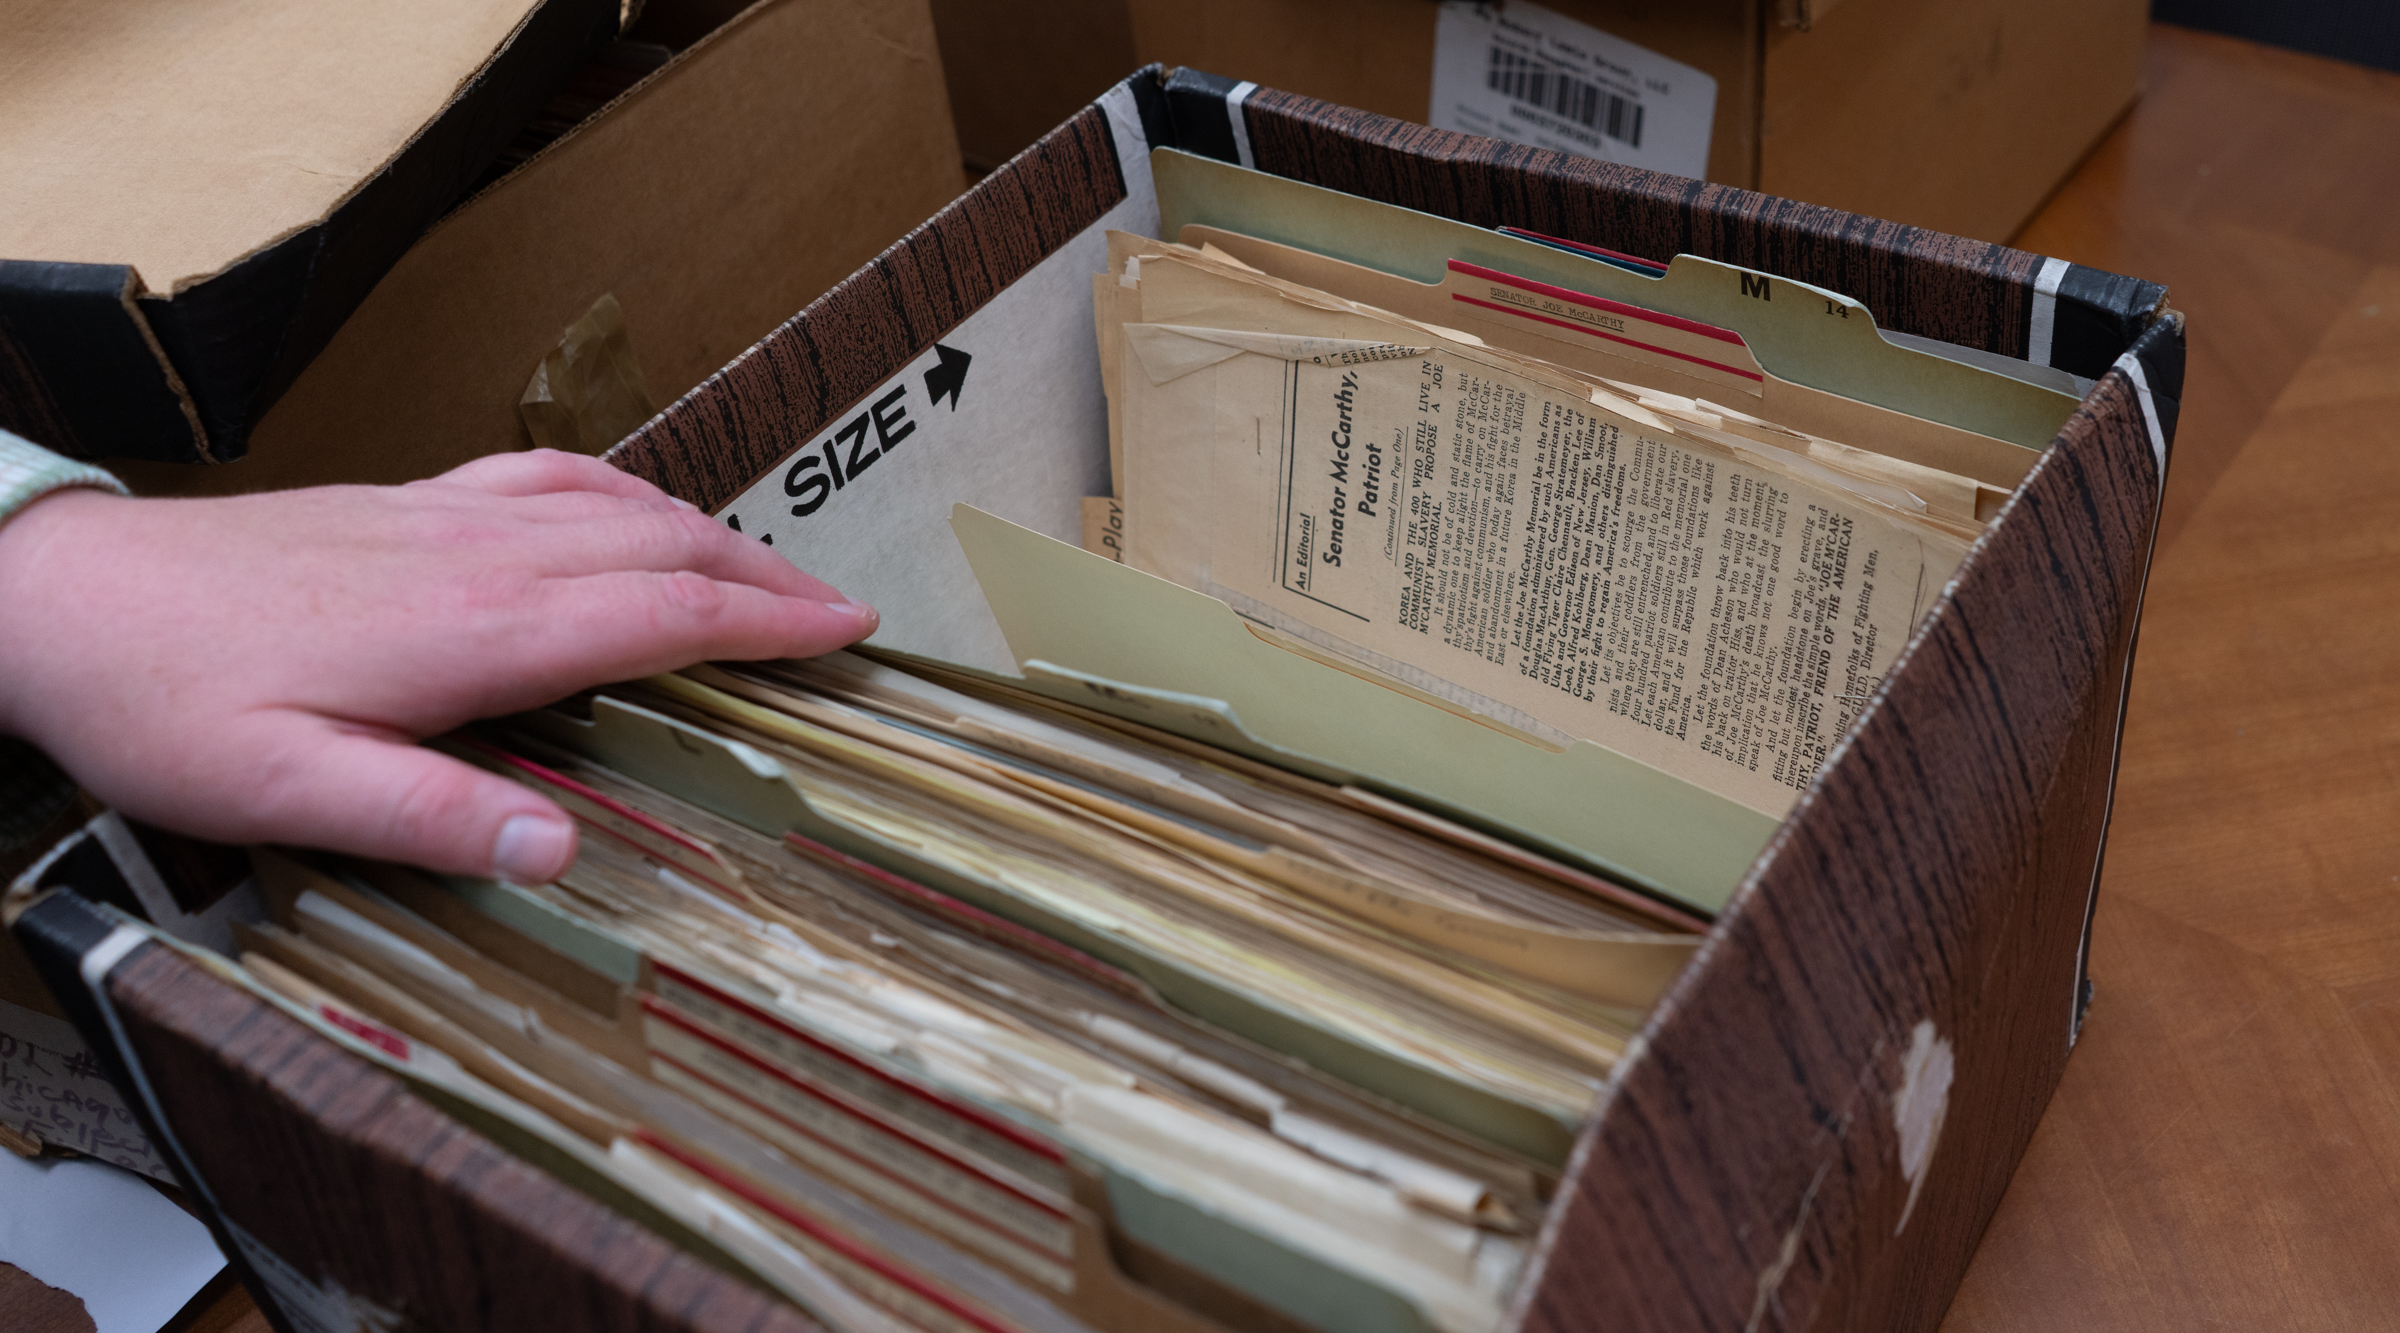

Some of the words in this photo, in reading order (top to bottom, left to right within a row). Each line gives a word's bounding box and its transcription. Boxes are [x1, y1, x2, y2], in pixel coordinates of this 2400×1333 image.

[1490, 287, 1536, 306] SENATOR
[1543, 301, 1563, 313] JOE
[1568, 307, 1625, 329] McCARTHY
[1740, 272, 1771, 302] M
[1824, 300, 1849, 319] 14
[1421, 359, 1431, 376] IN
[1432, 363, 1443, 389] JOE
[1457, 372, 1468, 391] but
[1418, 381, 1429, 412] LIVE
[1554, 404, 1562, 417] as
[1330, 371, 1359, 484] McCarthy,
[1454, 397, 1467, 429] stone,
[1538, 401, 1551, 429] form
[1562, 408, 1573, 427] the
[1575, 411, 1584, 425] of
[784, 384, 916, 517] SIZE
[1394, 428, 1405, 452] One)
[1415, 419, 1426, 453] STILL
[1451, 433, 1462, 462] static
[1536, 431, 1547, 449] the
[1544, 419, 1560, 479] Americans
[1571, 428, 1583, 449] Lee
[1581, 417, 1596, 460] William
[1593, 422, 1609, 460] Smoot,
[1391, 452, 1403, 479] Page
[1423, 423, 1437, 480] PROPOSE
[1534, 452, 1544, 463] in
[1553, 431, 1573, 501] Stratemeyer,
[1600, 424, 1619, 499] distinguished
[1629, 435, 1643, 481] Commu-
[1358, 443, 1382, 517] Patriot
[1411, 458, 1422, 488] WHO
[1449, 466, 1459, 487] and
[1532, 465, 1543, 479] be
[1564, 451, 1580, 499] Bracken
[1576, 466, 1592, 505] Jersey,
[1590, 464, 1602, 487] Dan
[1389, 479, 1400, 505] from
[1446, 490, 1456, 513] cold
[1542, 482, 1553, 507] such
[1610, 463, 1626, 517] freedoms.
[1626, 487, 1637, 505] the
[1727, 473, 1740, 502] teeth
[1410, 495, 1419, 515] 400
[1417, 490, 1430, 547] SLAVERY
[1526, 480, 1541, 533] Memorial
[1538, 508, 1550, 523] by
[1572, 506, 1584, 533] New
[1584, 491, 1600, 535] Manion,
[1724, 506, 1736, 524] his
[1102, 501, 1123, 563] -Play
[1323, 487, 1346, 567] Senator
[1383, 505, 1397, 561] (Continued
[1406, 520, 1416, 545] THE
[1444, 515, 1453, 529] of
[1547, 503, 1563, 543] George
[1556, 503, 1575, 561] Chennault,
[1596, 504, 1609, 540] others
[1622, 510, 1635, 553] scourge
[1297, 513, 1311, 569] Editorial
[1441, 532, 1452, 545] be
[1571, 534, 1581, 548] of
[1579, 539, 1592, 568] Dean
[1602, 520, 1619, 576] America's
[1720, 527, 1732, 550] into
[1799, 516, 1815, 563] erecting
[1832, 516, 1853, 590] AMERICAN
[1403, 552, 1413, 579] AND
[1418, 570, 1433, 634] M'CARTHY
[1426, 501, 1441, 569] MEMORIAL.
[1441, 548, 1450, 566] not
[1519, 534, 1535, 588] McCarthy
[1530, 524, 1547, 595] administered
[1543, 546, 1555, 571] Gen.
[1564, 550, 1579, 586] Edison
[1593, 543, 1603, 565] and
[1617, 557, 1627, 568] to
[1715, 553, 1729, 581] back
[1863, 546, 1879, 578] Men,
[1296, 572, 1307, 590] An
[1435, 568, 1448, 604] should
[1552, 564, 1565, 596] Claire
[1614, 574, 1625, 587] be
[1793, 567, 1807, 583] by
[1398, 586, 1410, 626] KOREA
[1408, 557, 1424, 630] COMMUNIST
[1500, 570, 1515, 624] elsewhere.
[1516, 590, 1526, 609] Joe
[1535, 574, 1553, 636] MacArthur,
[1571, 571, 1589, 624] Kohlberg,
[1580, 571, 1601, 642] Montgomery,
[1599, 579, 1610, 614] regain
[1709, 584, 1724, 618] throw
[1787, 589, 1804, 619] begin
[1826, 593, 1840, 620] THE
[1853, 579, 1874, 630] Fighting
[1433, 606, 1443, 616] It
[1514, 610, 1524, 628] the
[1521, 597, 1537, 653] foundation
[1547, 599, 1560, 631] Tiger
[1557, 588, 1573, 638] Governor
[1595, 616, 1605, 628] to
[1606, 591, 1623, 646] objectives
[1813, 597, 1828, 631] words,
[1500, 627, 1507, 639] or
[1511, 629, 1521, 647] Let
[1566, 625, 1580, 663] Alfred
[1590, 631, 1602, 657] fight
[1822, 624, 1834, 644] OF
[1850, 630, 1863, 645] of
[1494, 642, 1506, 666] East
[1528, 637, 1545, 680] Douglas
[1542, 630, 1557, 667] Flying
[1556, 639, 1566, 661] and
[1578, 646, 1588, 656] S.
[1603, 648, 1614, 662] its
[1700, 622, 1718, 680] foundation
[1777, 625, 1796, 684] foundation
[1805, 634, 1820, 670] simple
[1519, 662, 1528, 675] of
[1540, 665, 1550, 684] old
[1550, 662, 1562, 688] Utah
[1561, 665, 1575, 694] Loeb,
[1572, 660, 1588, 700] George
[1586, 659, 1598, 685] their
[1599, 665, 1611, 684] Let
[1759, 645, 1778, 701] McCarthy.
[1801, 671, 1814, 689] the
[1813, 649, 1830, 697] FRIEND
[1838, 646, 1860, 708] Homefolks
[1851, 672, 1869, 717] GUILD,
[1860, 622, 1877, 670] Director
[1583, 688, 1595, 702] by
[1696, 683, 1708, 701] the
[1773, 688, 1785, 705] the
[1675, 694, 1692, 741] America.
[1693, 703, 1705, 723] Let
[1755, 704, 1767, 723] Joe
[1769, 709, 1781, 725] let
[1793, 691, 1810, 733] inscribe
[1753, 724, 1763, 737] of
[1765, 728, 1778, 753] And
[1801, 702, 1822, 759] PATRIOT,
[1831, 709, 1849, 755] ighting
[1748, 739, 1763, 772] speak
[1784, 734, 1802, 790] thereupon
[1795, 763, 1811, 795] THY,
